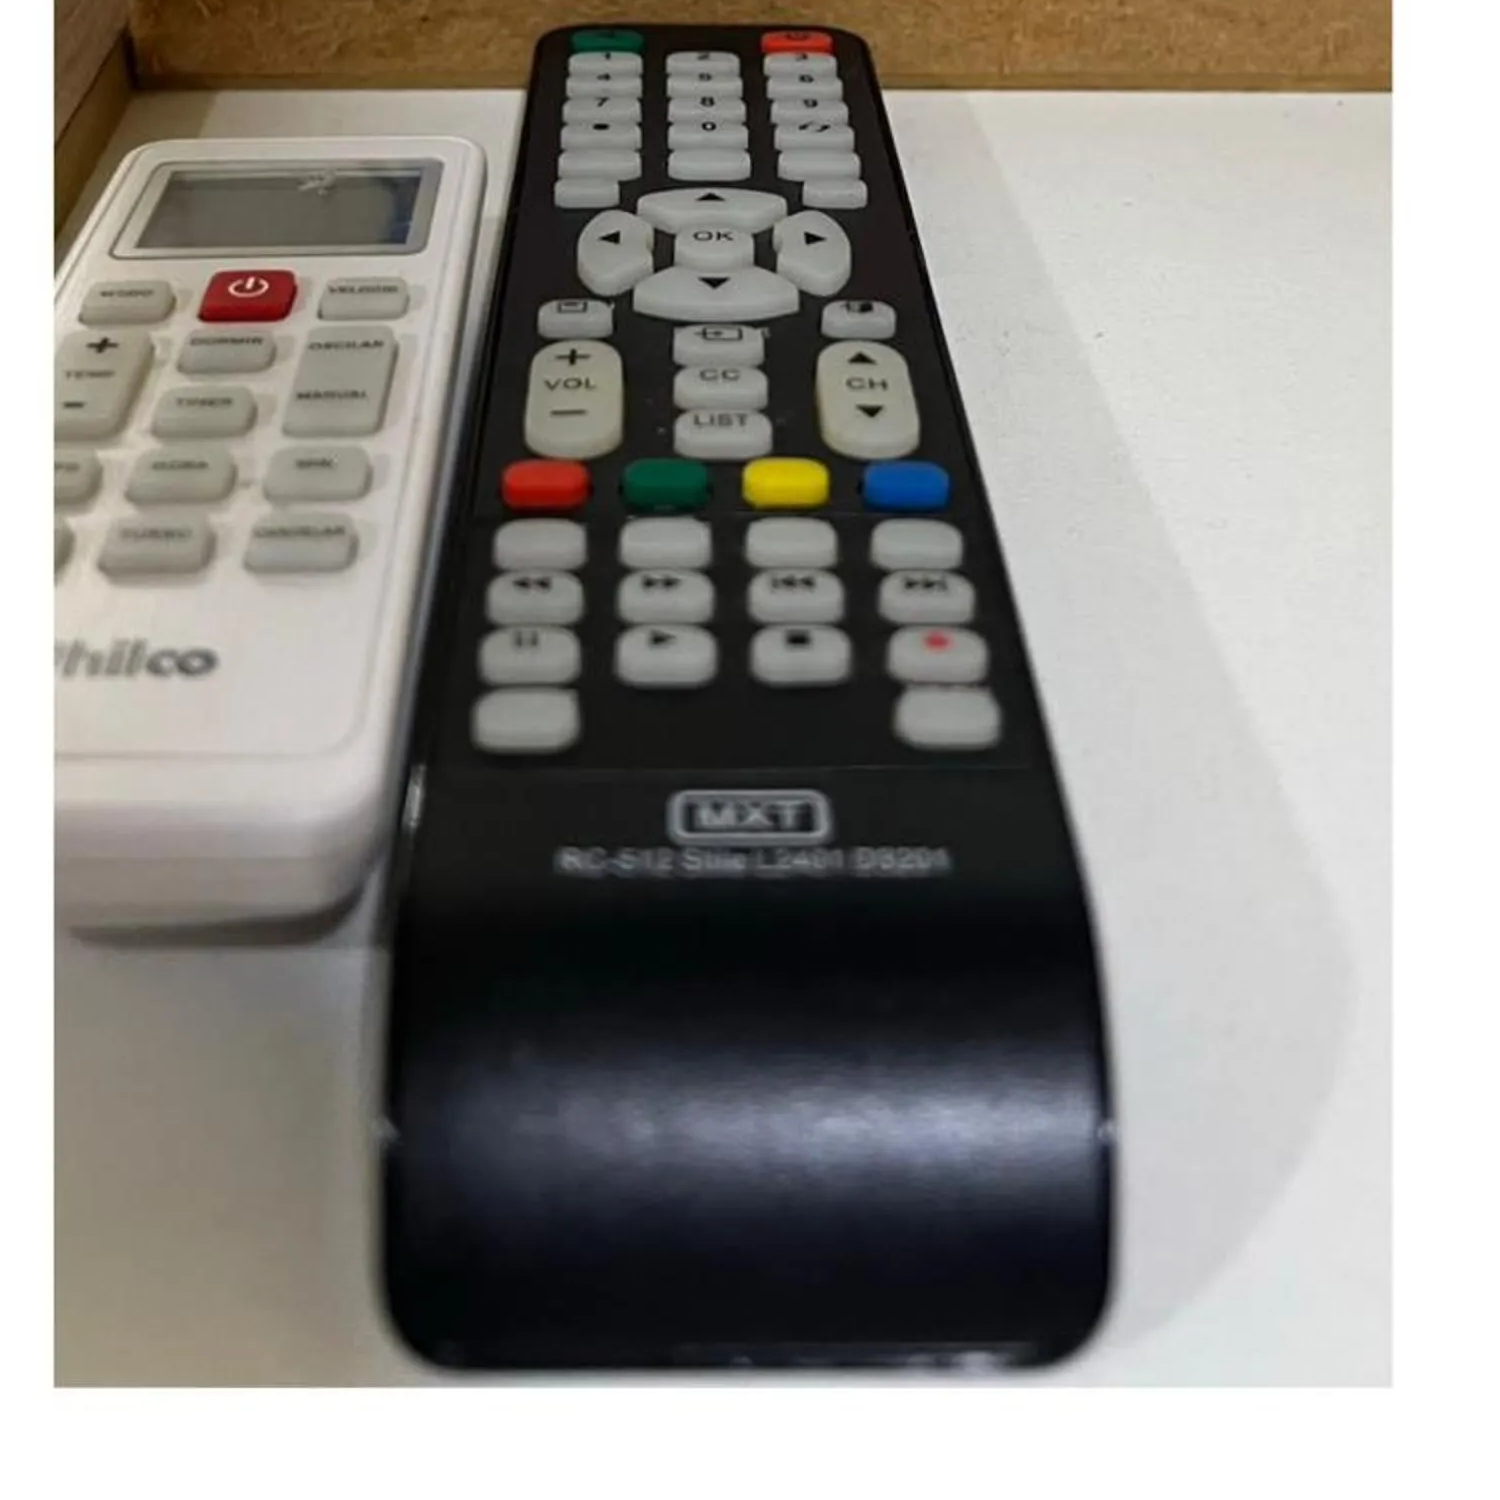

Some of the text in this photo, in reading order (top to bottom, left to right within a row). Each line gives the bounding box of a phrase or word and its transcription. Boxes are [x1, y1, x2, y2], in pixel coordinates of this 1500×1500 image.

[692, 230, 734, 243] OK
[700, 368, 741, 383] CC
[543, 377, 597, 391] VOL
[845, 377, 890, 392] CH
[693, 414, 749, 428] LIST
[696, 800, 808, 829] MXT
